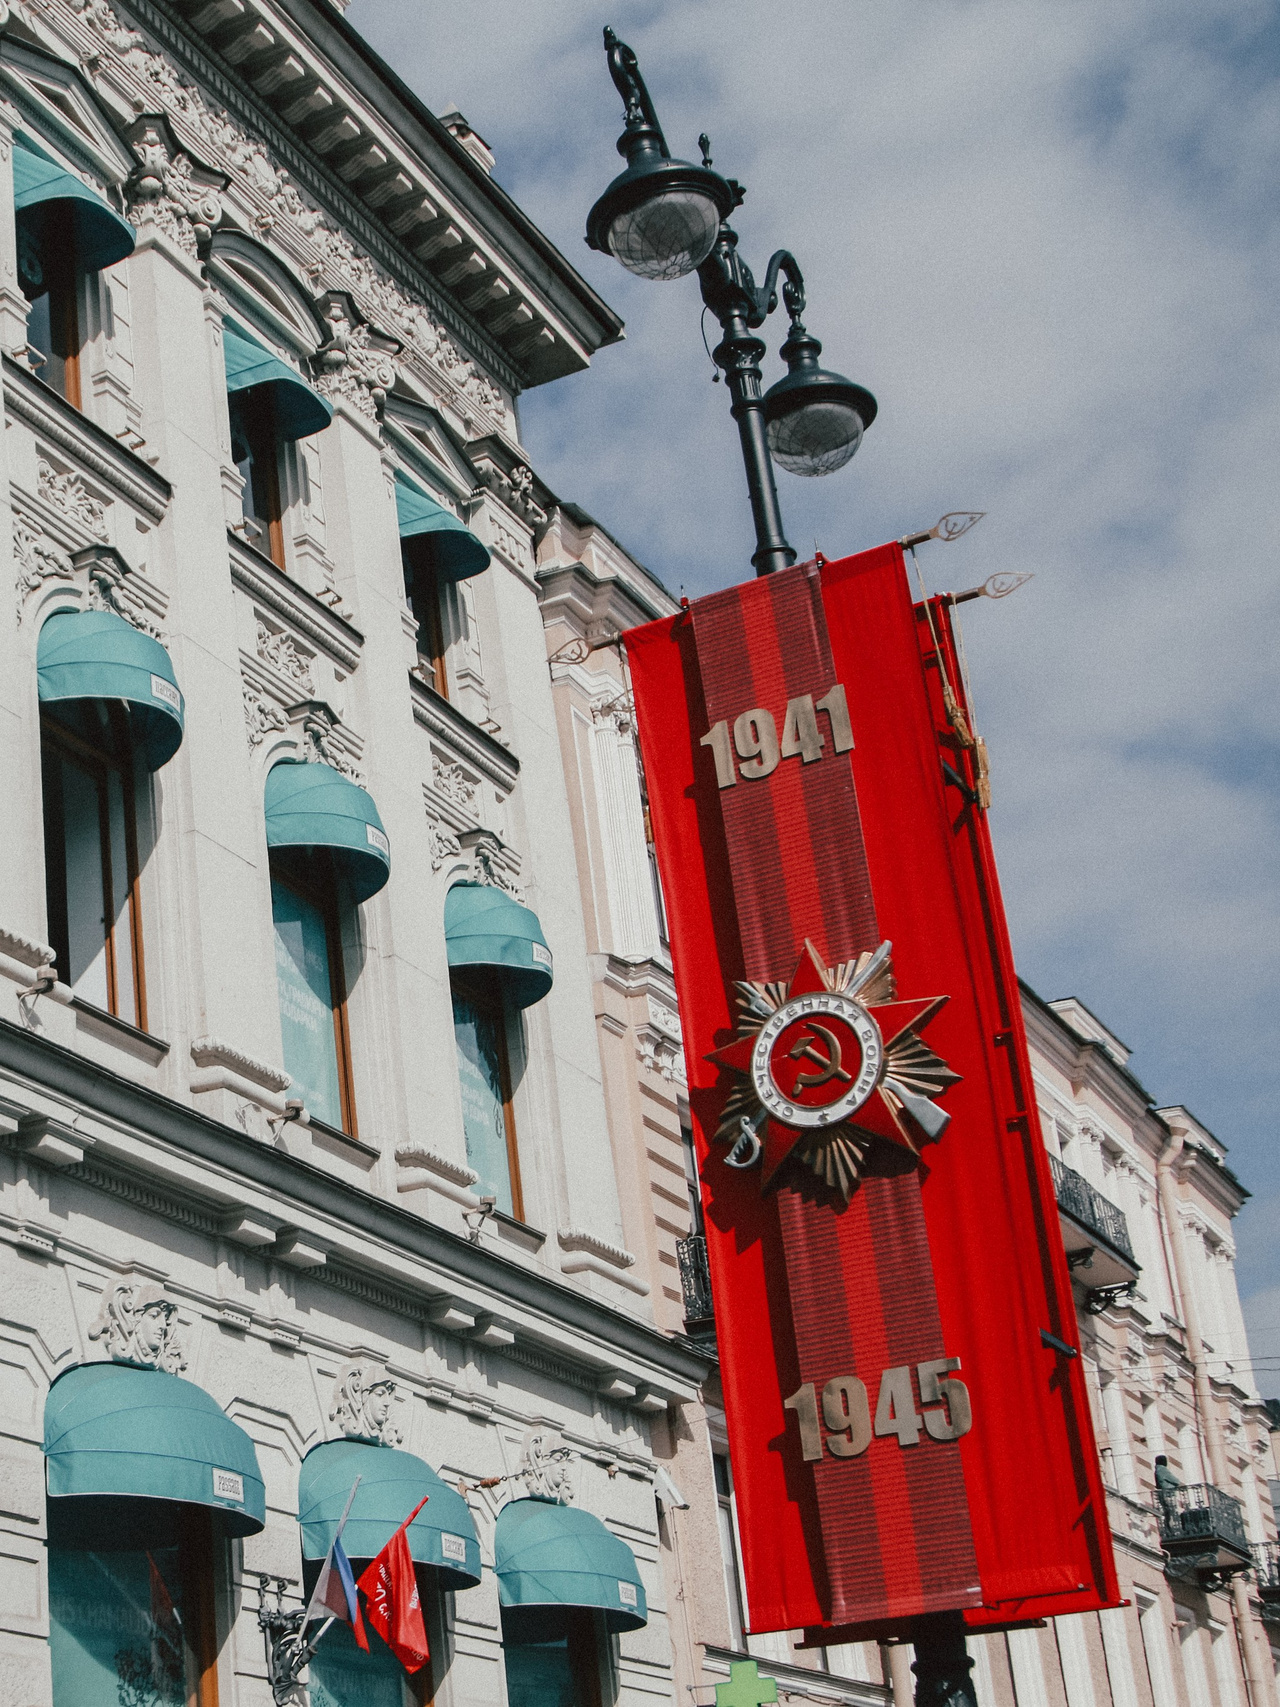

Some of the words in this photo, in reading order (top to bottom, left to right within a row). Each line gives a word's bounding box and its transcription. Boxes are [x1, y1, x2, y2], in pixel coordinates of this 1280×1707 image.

[700, 684, 856, 789] 1941
[755, 997, 862, 1118] ОТЕЧЕСТВЕННАЯ
[845, 1029, 878, 1107] ВОЙНА
[784, 1356, 973, 1462] 1945
